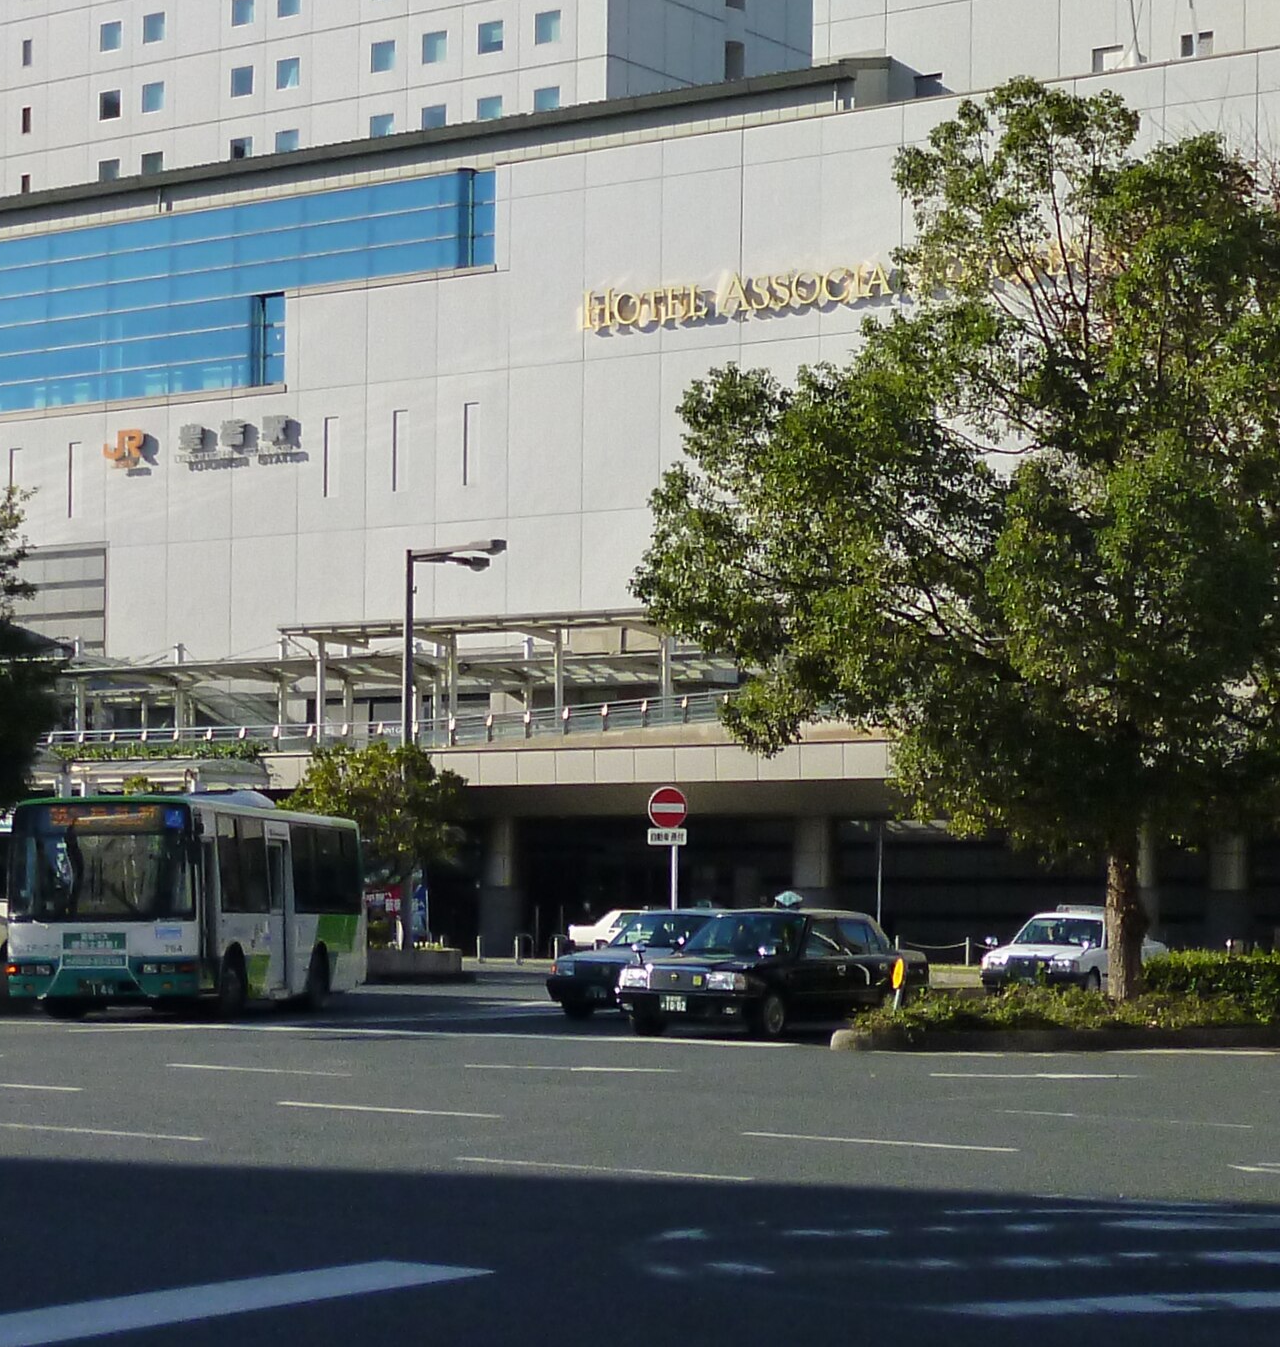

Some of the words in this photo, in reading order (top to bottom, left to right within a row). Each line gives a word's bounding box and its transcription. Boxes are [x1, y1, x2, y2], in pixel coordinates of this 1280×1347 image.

[582, 283, 708, 330] HOTEL
[720, 262, 894, 314] ASSOCIA
[103, 428, 144, 461] JR
